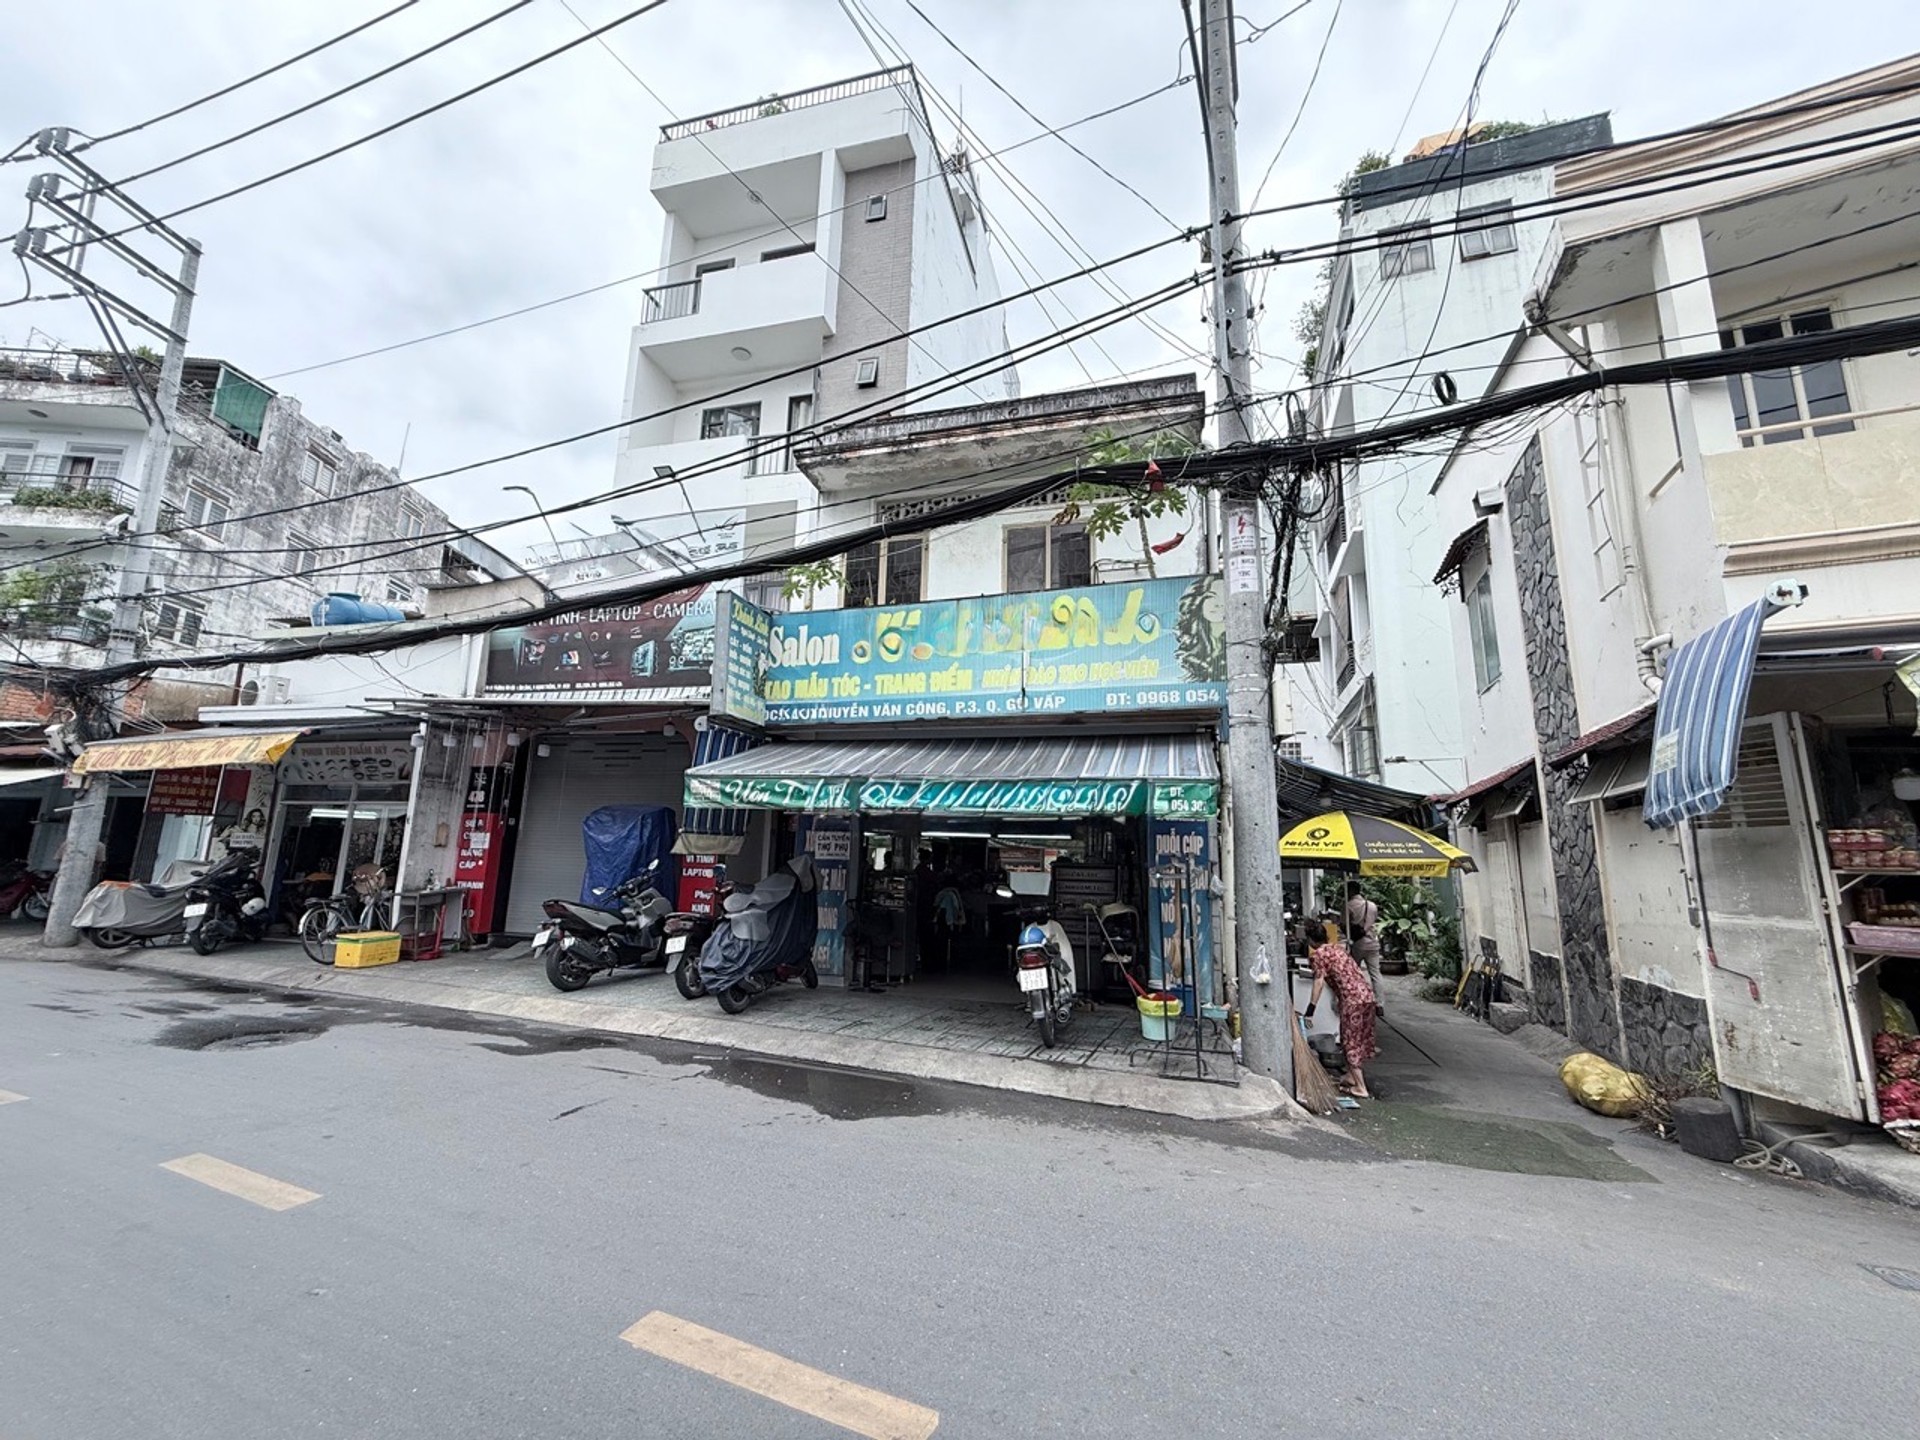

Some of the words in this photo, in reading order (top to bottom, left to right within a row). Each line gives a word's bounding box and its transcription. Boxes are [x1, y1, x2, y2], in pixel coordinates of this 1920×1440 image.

[589, 607, 641, 623] LAPTOP
[653, 601, 714, 618] CAMERA
[769, 624, 840, 668] Salon
[831, 672, 861, 697] TÓC
[875, 672, 926, 696] TRANG
[872, 702, 901, 717] VĂN
[905, 700, 950, 716] CÔNG,
[1033, 692, 1066, 709] VẤP
[1106, 693, 1131, 706] ĐT:
[1136, 690, 1180, 704] 0968
[1185, 689, 1220, 703] 054
